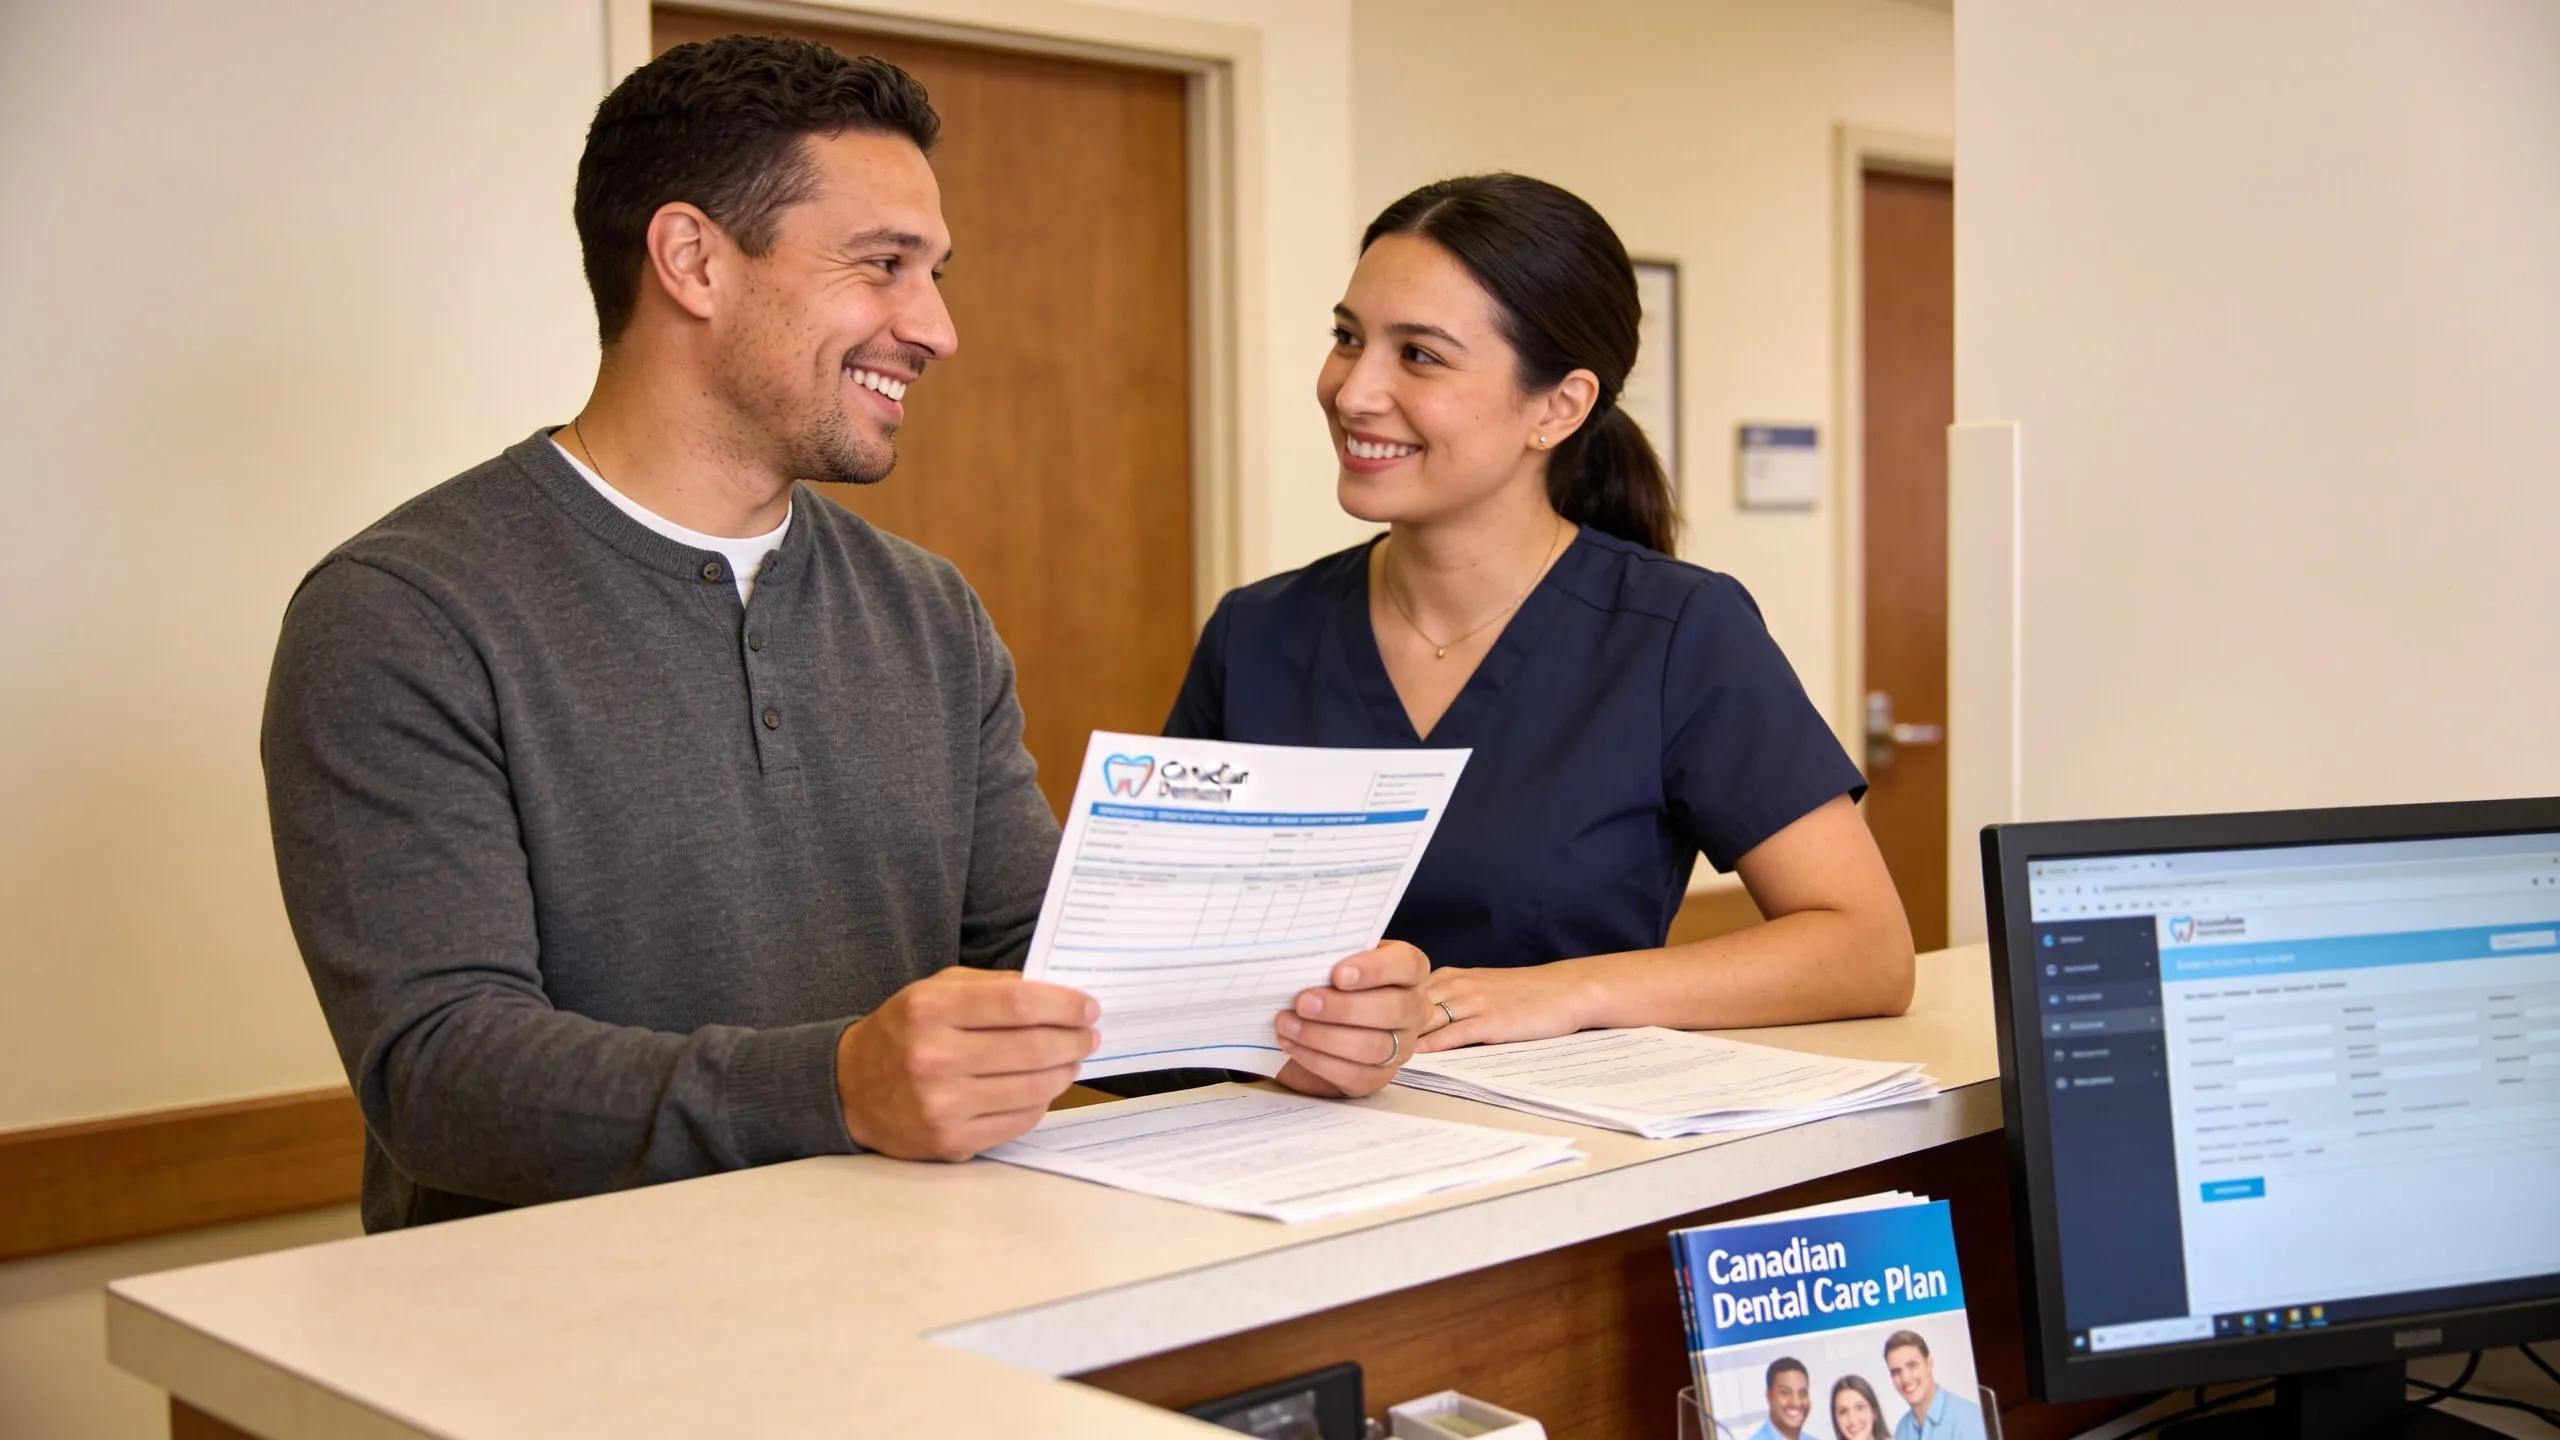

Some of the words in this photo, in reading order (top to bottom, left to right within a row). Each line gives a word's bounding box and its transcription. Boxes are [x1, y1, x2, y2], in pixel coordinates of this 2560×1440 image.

[1707, 1237, 1847, 1286] Canadian
[1712, 1279, 1810, 1329] Dental
[1813, 1277, 1880, 1313] Care
[1884, 1264, 1948, 1304] Plan
